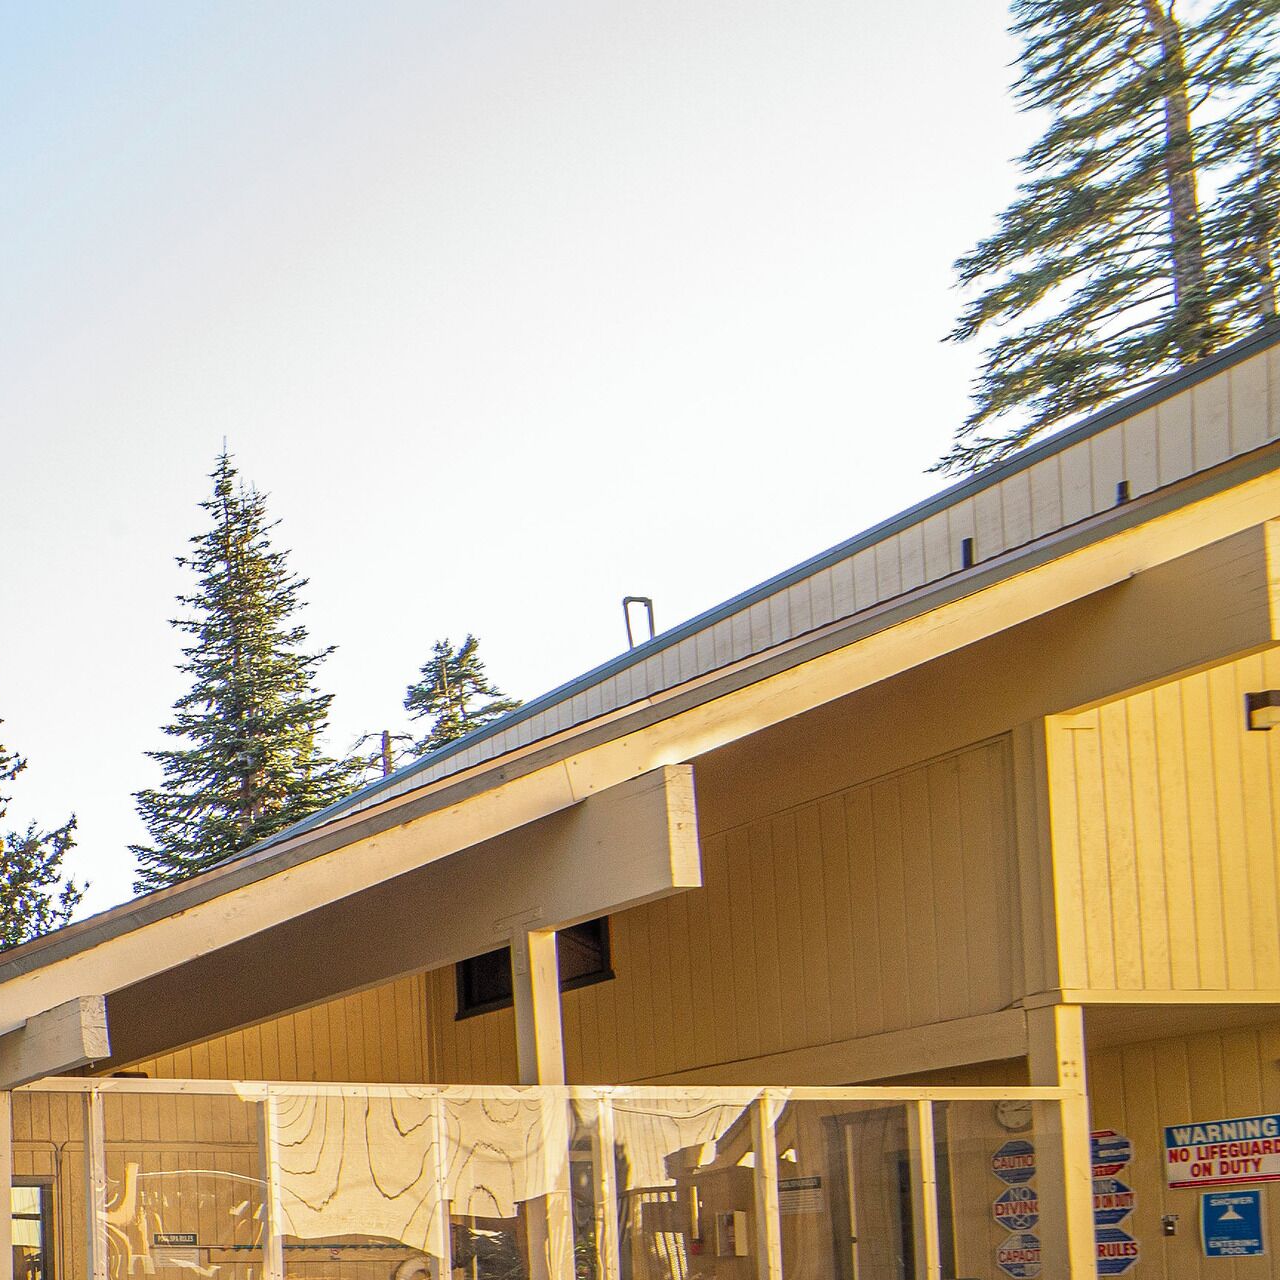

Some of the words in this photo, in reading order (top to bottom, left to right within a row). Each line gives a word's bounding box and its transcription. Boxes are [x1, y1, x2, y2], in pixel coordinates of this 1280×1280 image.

[1172, 1118, 1277, 1146] WARNING
[1168, 1148, 1189, 1163] NO
[1196, 1139, 1280, 1160] LIFEGUARD
[992, 1154, 1034, 1169] CAUTIO
[1191, 1163, 1212, 1177] ON
[1220, 1158, 1262, 1175] DUTY
[1010, 1188, 1030, 1201] NO
[1210, 1197, 1254, 1206] SHOWER
[1097, 1242, 1138, 1257] RULES
[1209, 1239, 1259, 1248] ENTERING
[1220, 1247, 1249, 1255] POOL
[998, 1248, 1040, 1264] CAPACIT
